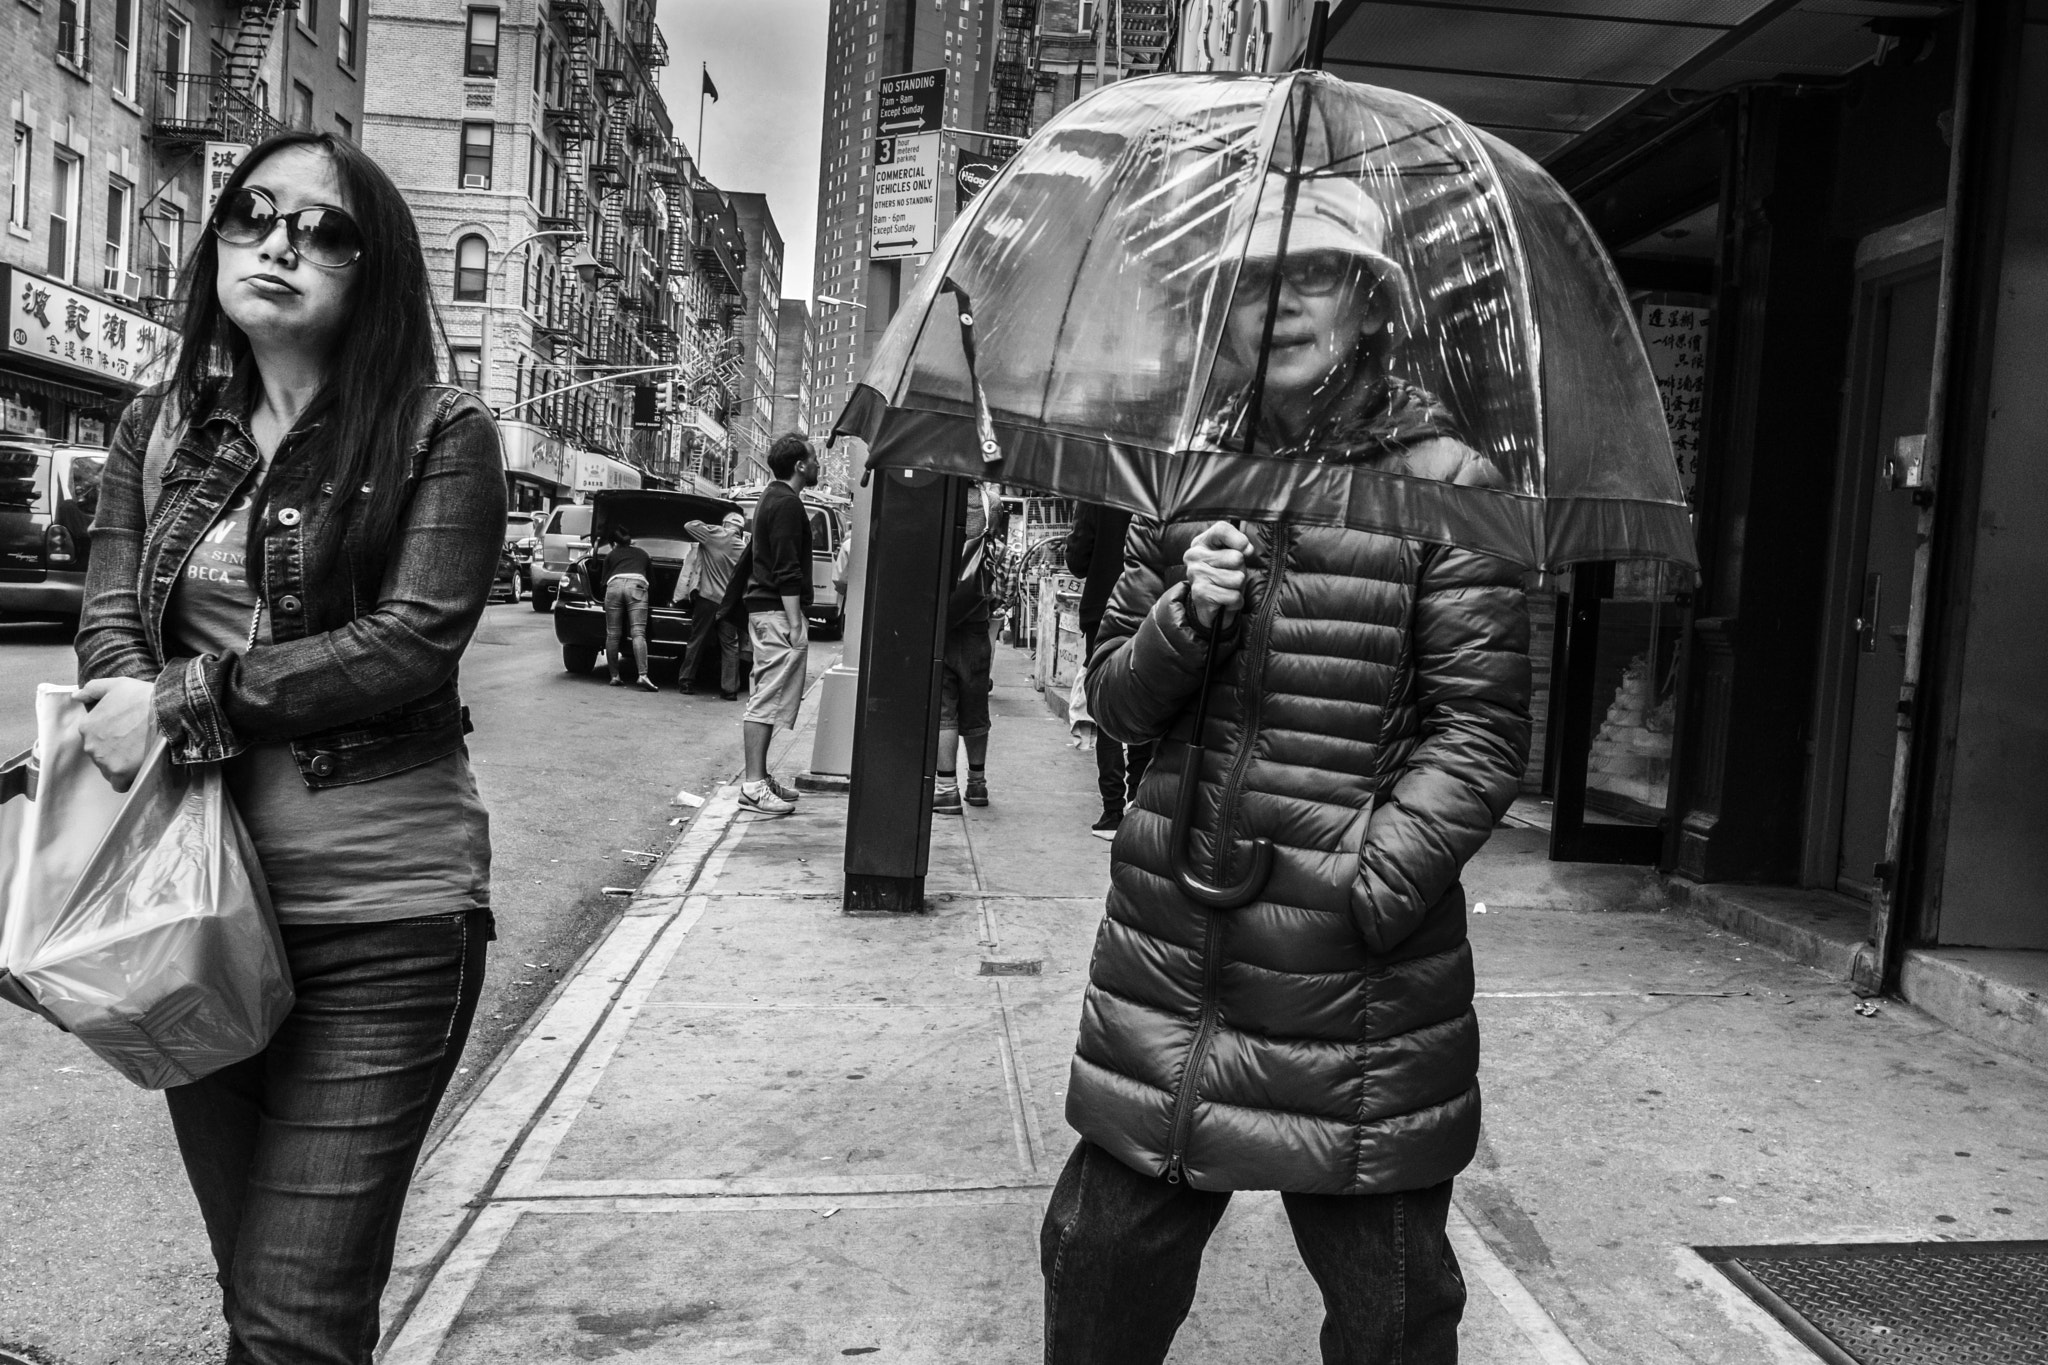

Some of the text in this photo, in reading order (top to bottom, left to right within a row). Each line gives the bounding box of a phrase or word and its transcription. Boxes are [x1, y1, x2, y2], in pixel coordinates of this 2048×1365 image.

[882, 75, 935, 94] NO STANDING
[881, 97, 895, 107] 7am
[899, 94, 914, 104] 8am
[880, 104, 925, 118] Except Sunday
[879, 139, 891, 163] 3
[897, 145, 920, 155] metered
[896, 154, 917, 164] parking
[876, 166, 926, 182] COMMERCIAL
[875, 178, 933, 195] VEHICLES ONLY
[874, 195, 933, 209] OTHERS NO STANDING
[873, 214, 887, 224] 8am
[892, 213, 906, 223] 6pm
[873, 223, 916, 236] Except Sunday
[22, 281, 158, 353] 波記潮州
[14, 329, 27, 345] 80
[1027, 499, 1073, 524] ATM
